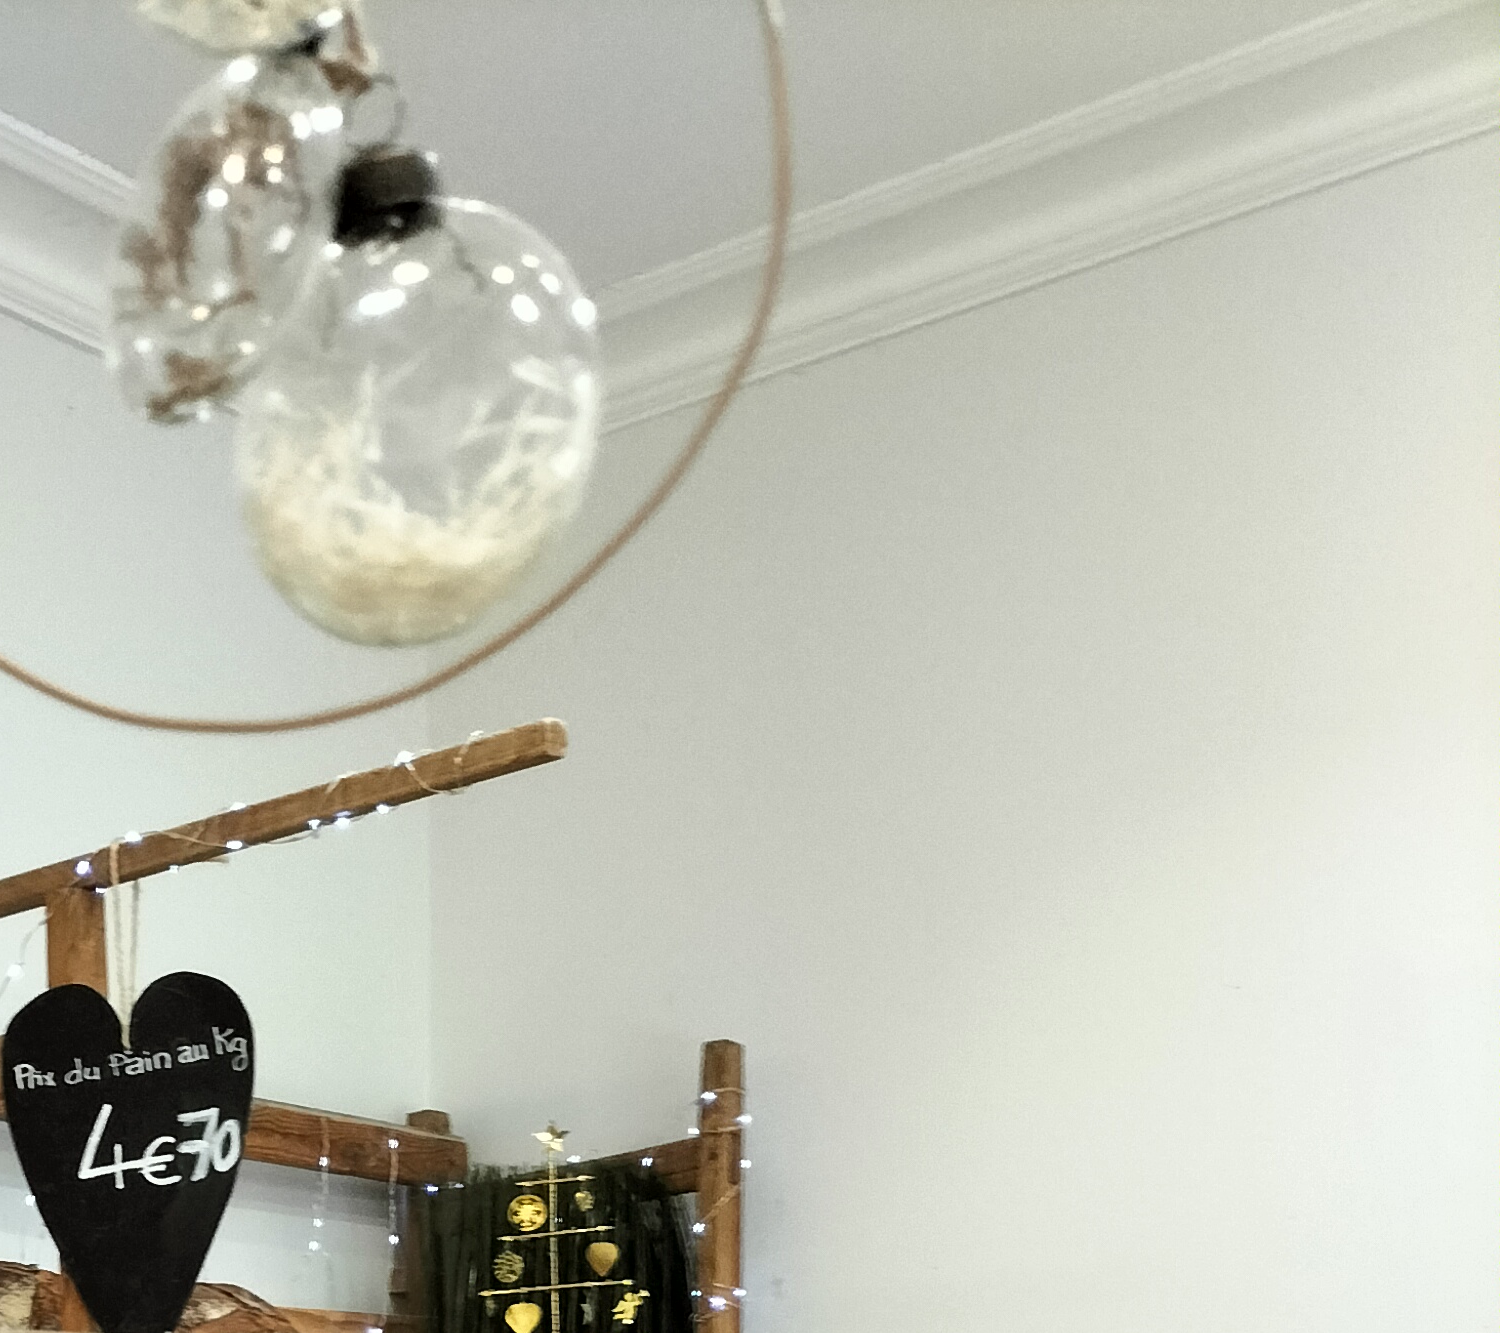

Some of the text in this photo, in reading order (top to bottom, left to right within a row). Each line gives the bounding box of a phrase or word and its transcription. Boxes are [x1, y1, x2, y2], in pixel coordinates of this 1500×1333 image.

[12, 1026, 249, 1090] Prix du Pain au Kg
